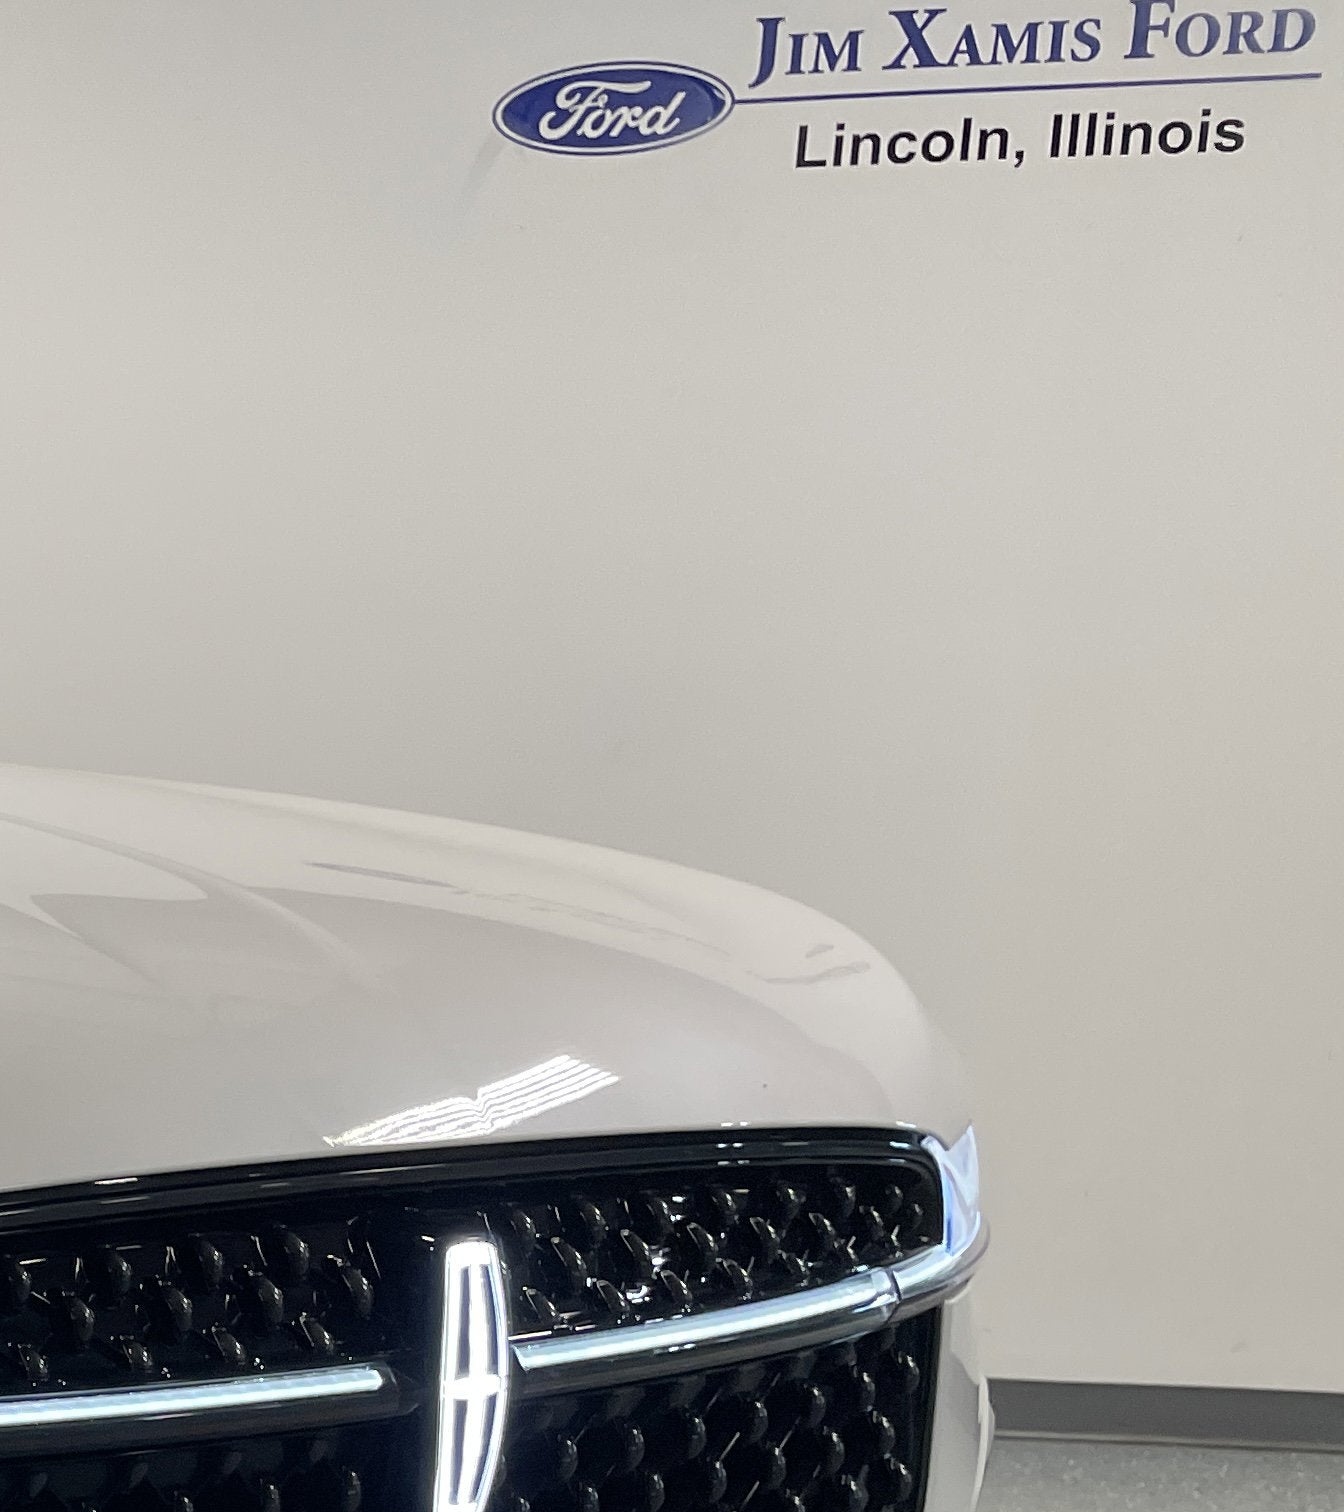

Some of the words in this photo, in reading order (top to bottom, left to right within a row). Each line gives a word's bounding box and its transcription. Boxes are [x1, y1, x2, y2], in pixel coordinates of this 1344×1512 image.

[749, 17, 864, 88] JIM
[882, 8, 1101, 70] XAMIS
[1124, 0, 1315, 59] FORD
[538, 80, 682, 140] Ford
[795, 118, 1025, 169] Lincoln,
[1050, 109, 1245, 158] Illinois
